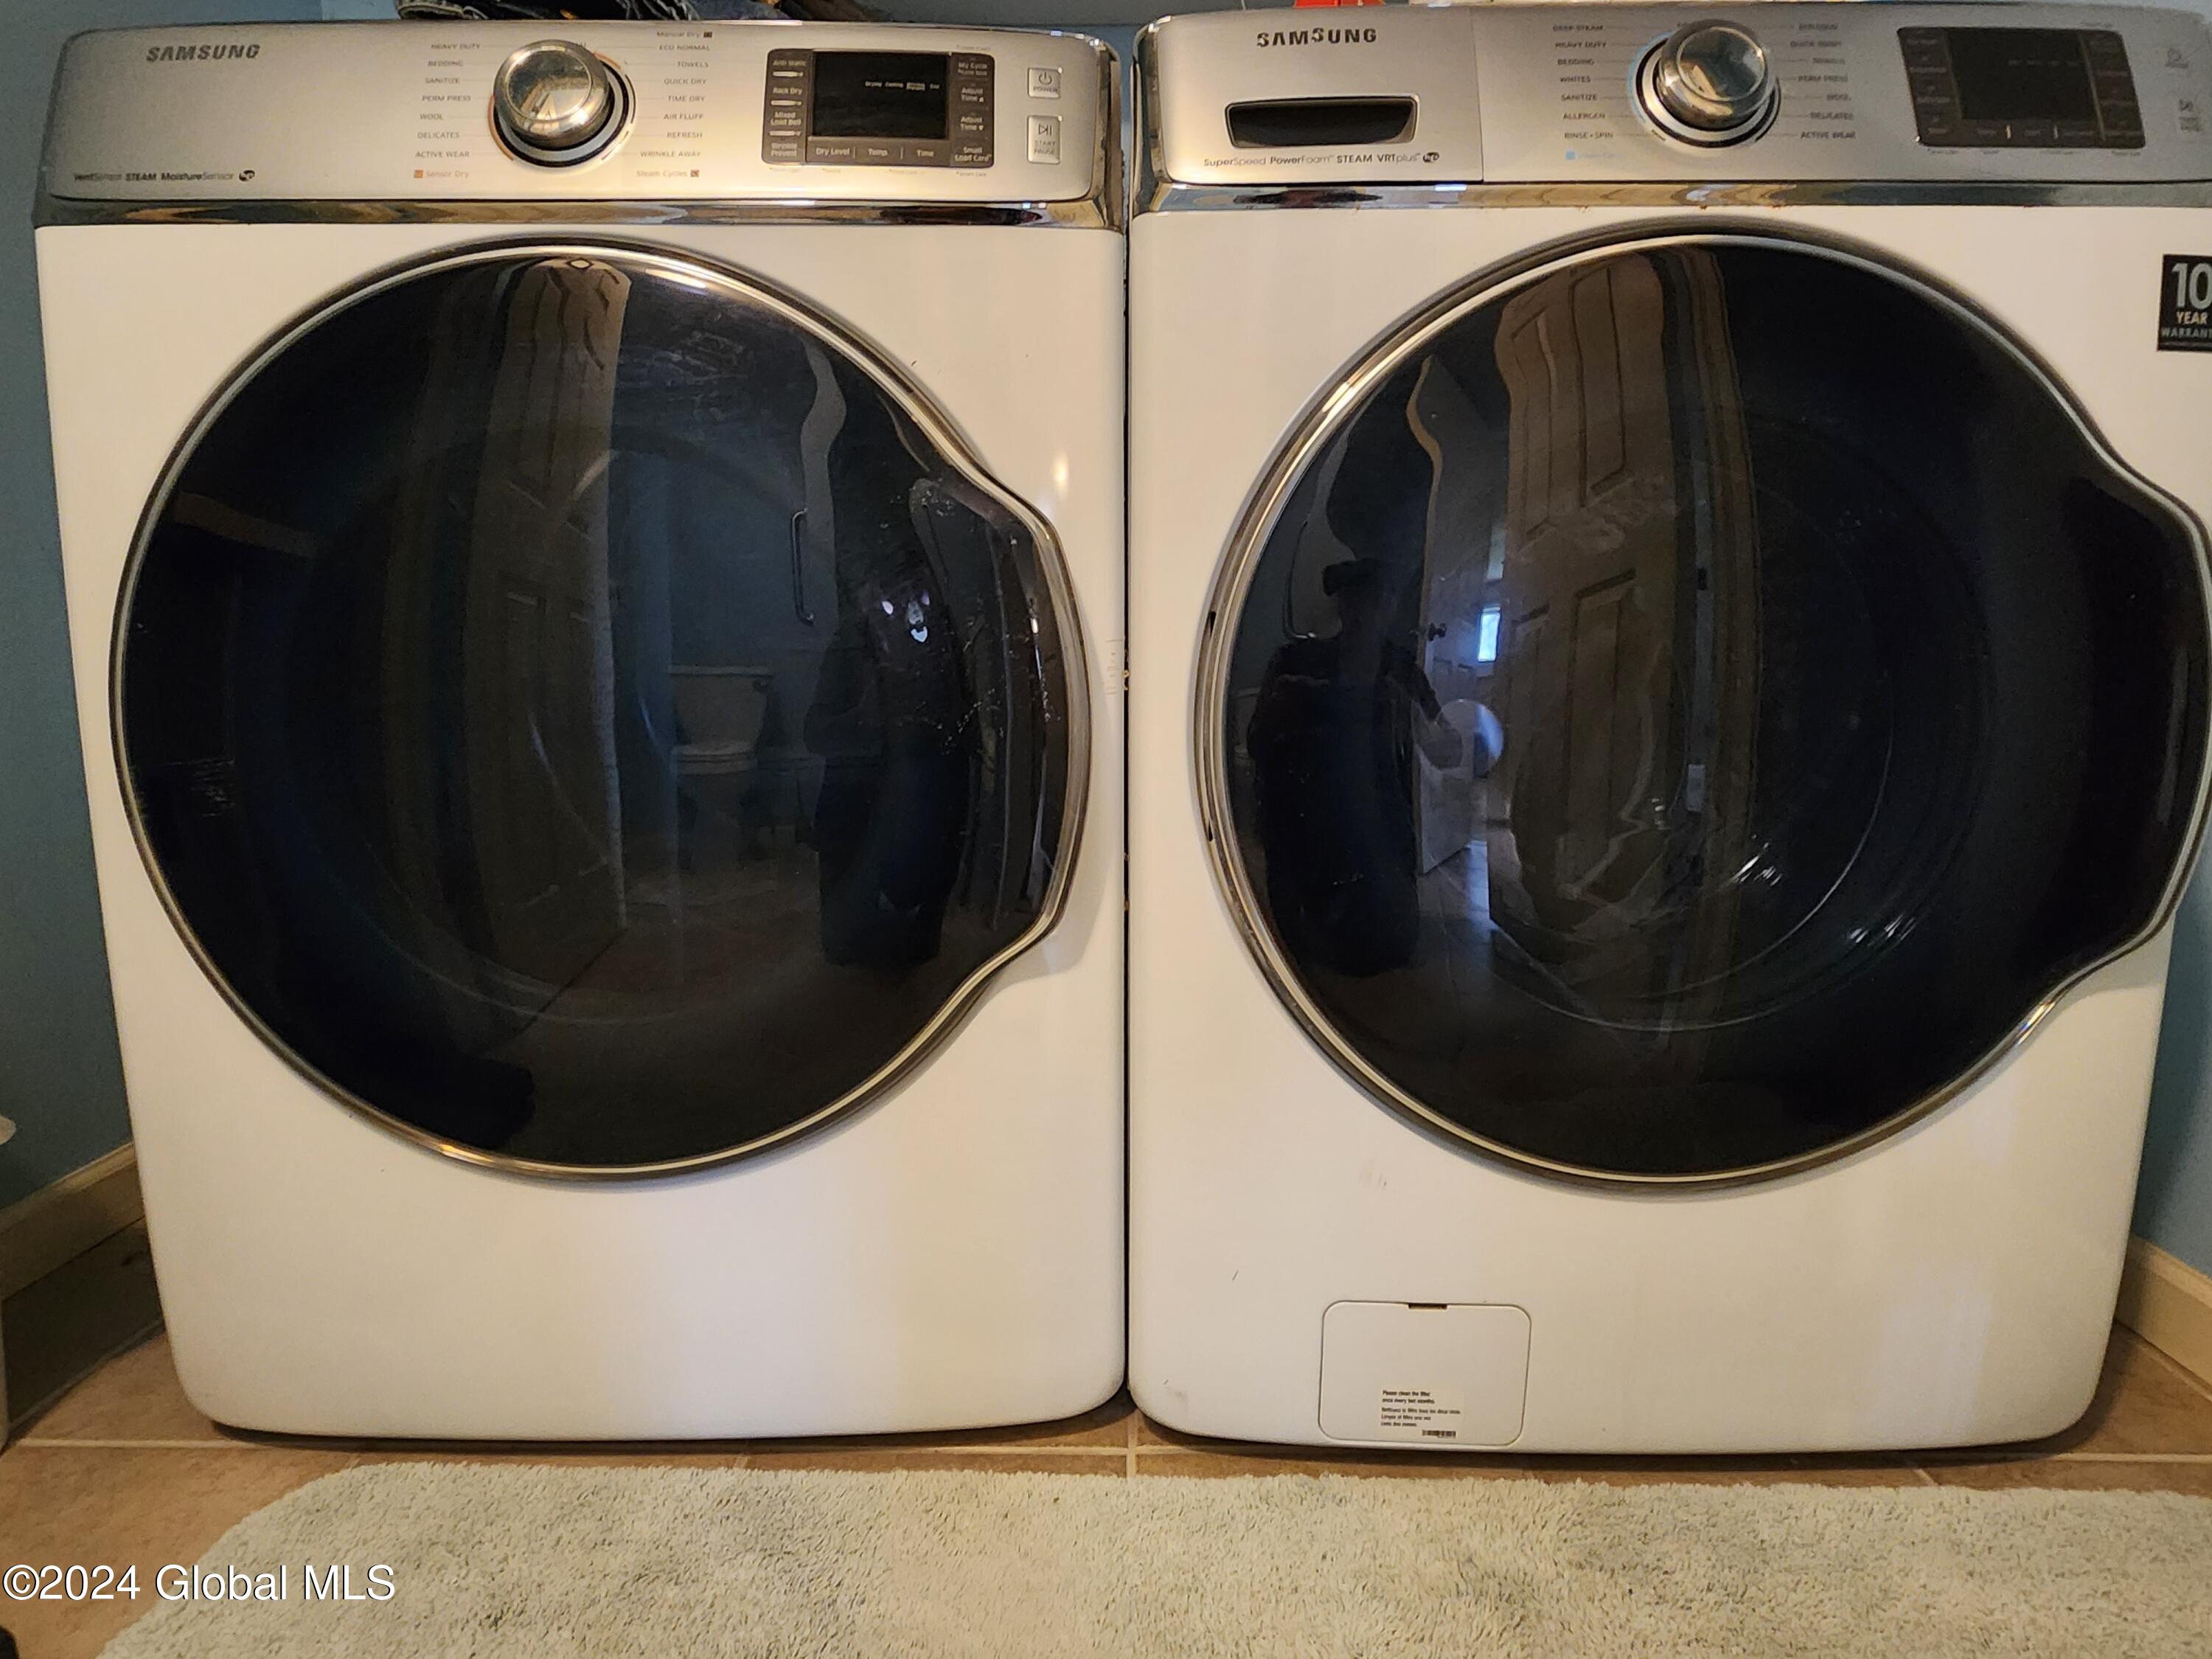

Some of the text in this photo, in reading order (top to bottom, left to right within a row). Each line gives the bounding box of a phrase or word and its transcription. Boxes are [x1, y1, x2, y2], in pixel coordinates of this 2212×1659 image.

[1256, 27, 1377, 48] SAMSUNG
[146, 44, 260, 62] SAMSUNG
[815, 147, 850, 156] Dry Level
[1203, 157, 1267, 168] SuperSpeed
[1337, 154, 1373, 164] STEAM
[125, 173, 157, 181] STEAM
[454, 170, 470, 179] Dry
[2171, 262, 2212, 310] 10
[2176, 311, 2208, 324] YEAR
